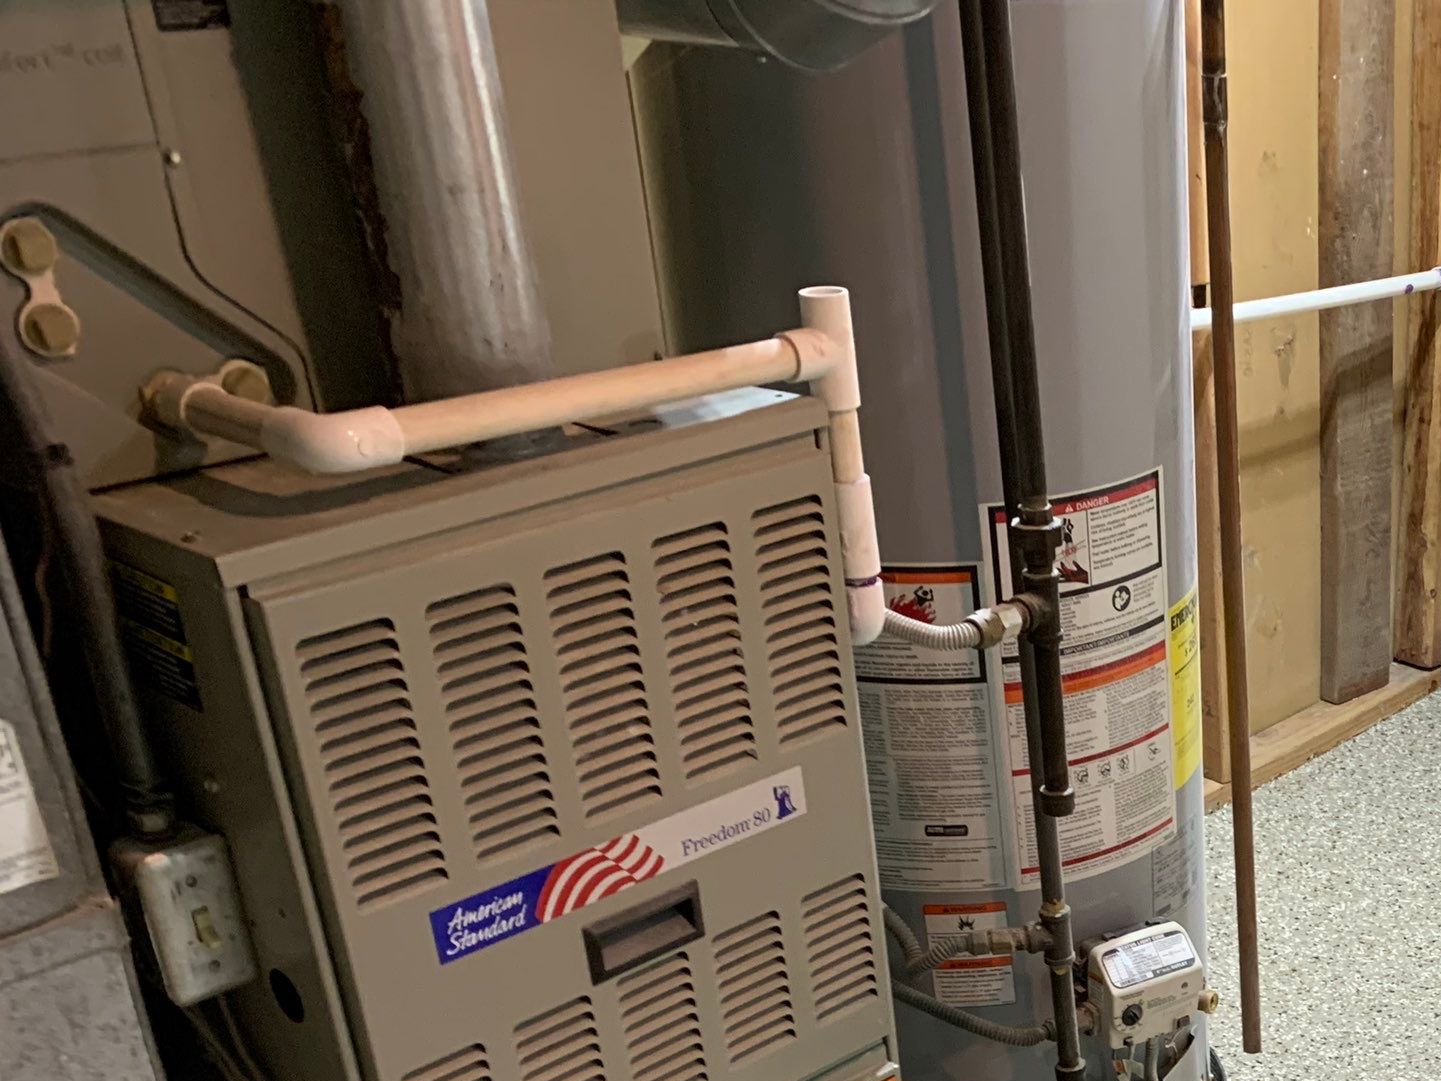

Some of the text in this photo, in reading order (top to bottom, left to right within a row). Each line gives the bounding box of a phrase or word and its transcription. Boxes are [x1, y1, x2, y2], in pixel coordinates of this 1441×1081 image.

[1075, 496, 1109, 511] DANGER
[681, 807, 771, 857] Freedom 80
[446, 903, 527, 956] Standard
[447, 891, 523, 935] American
